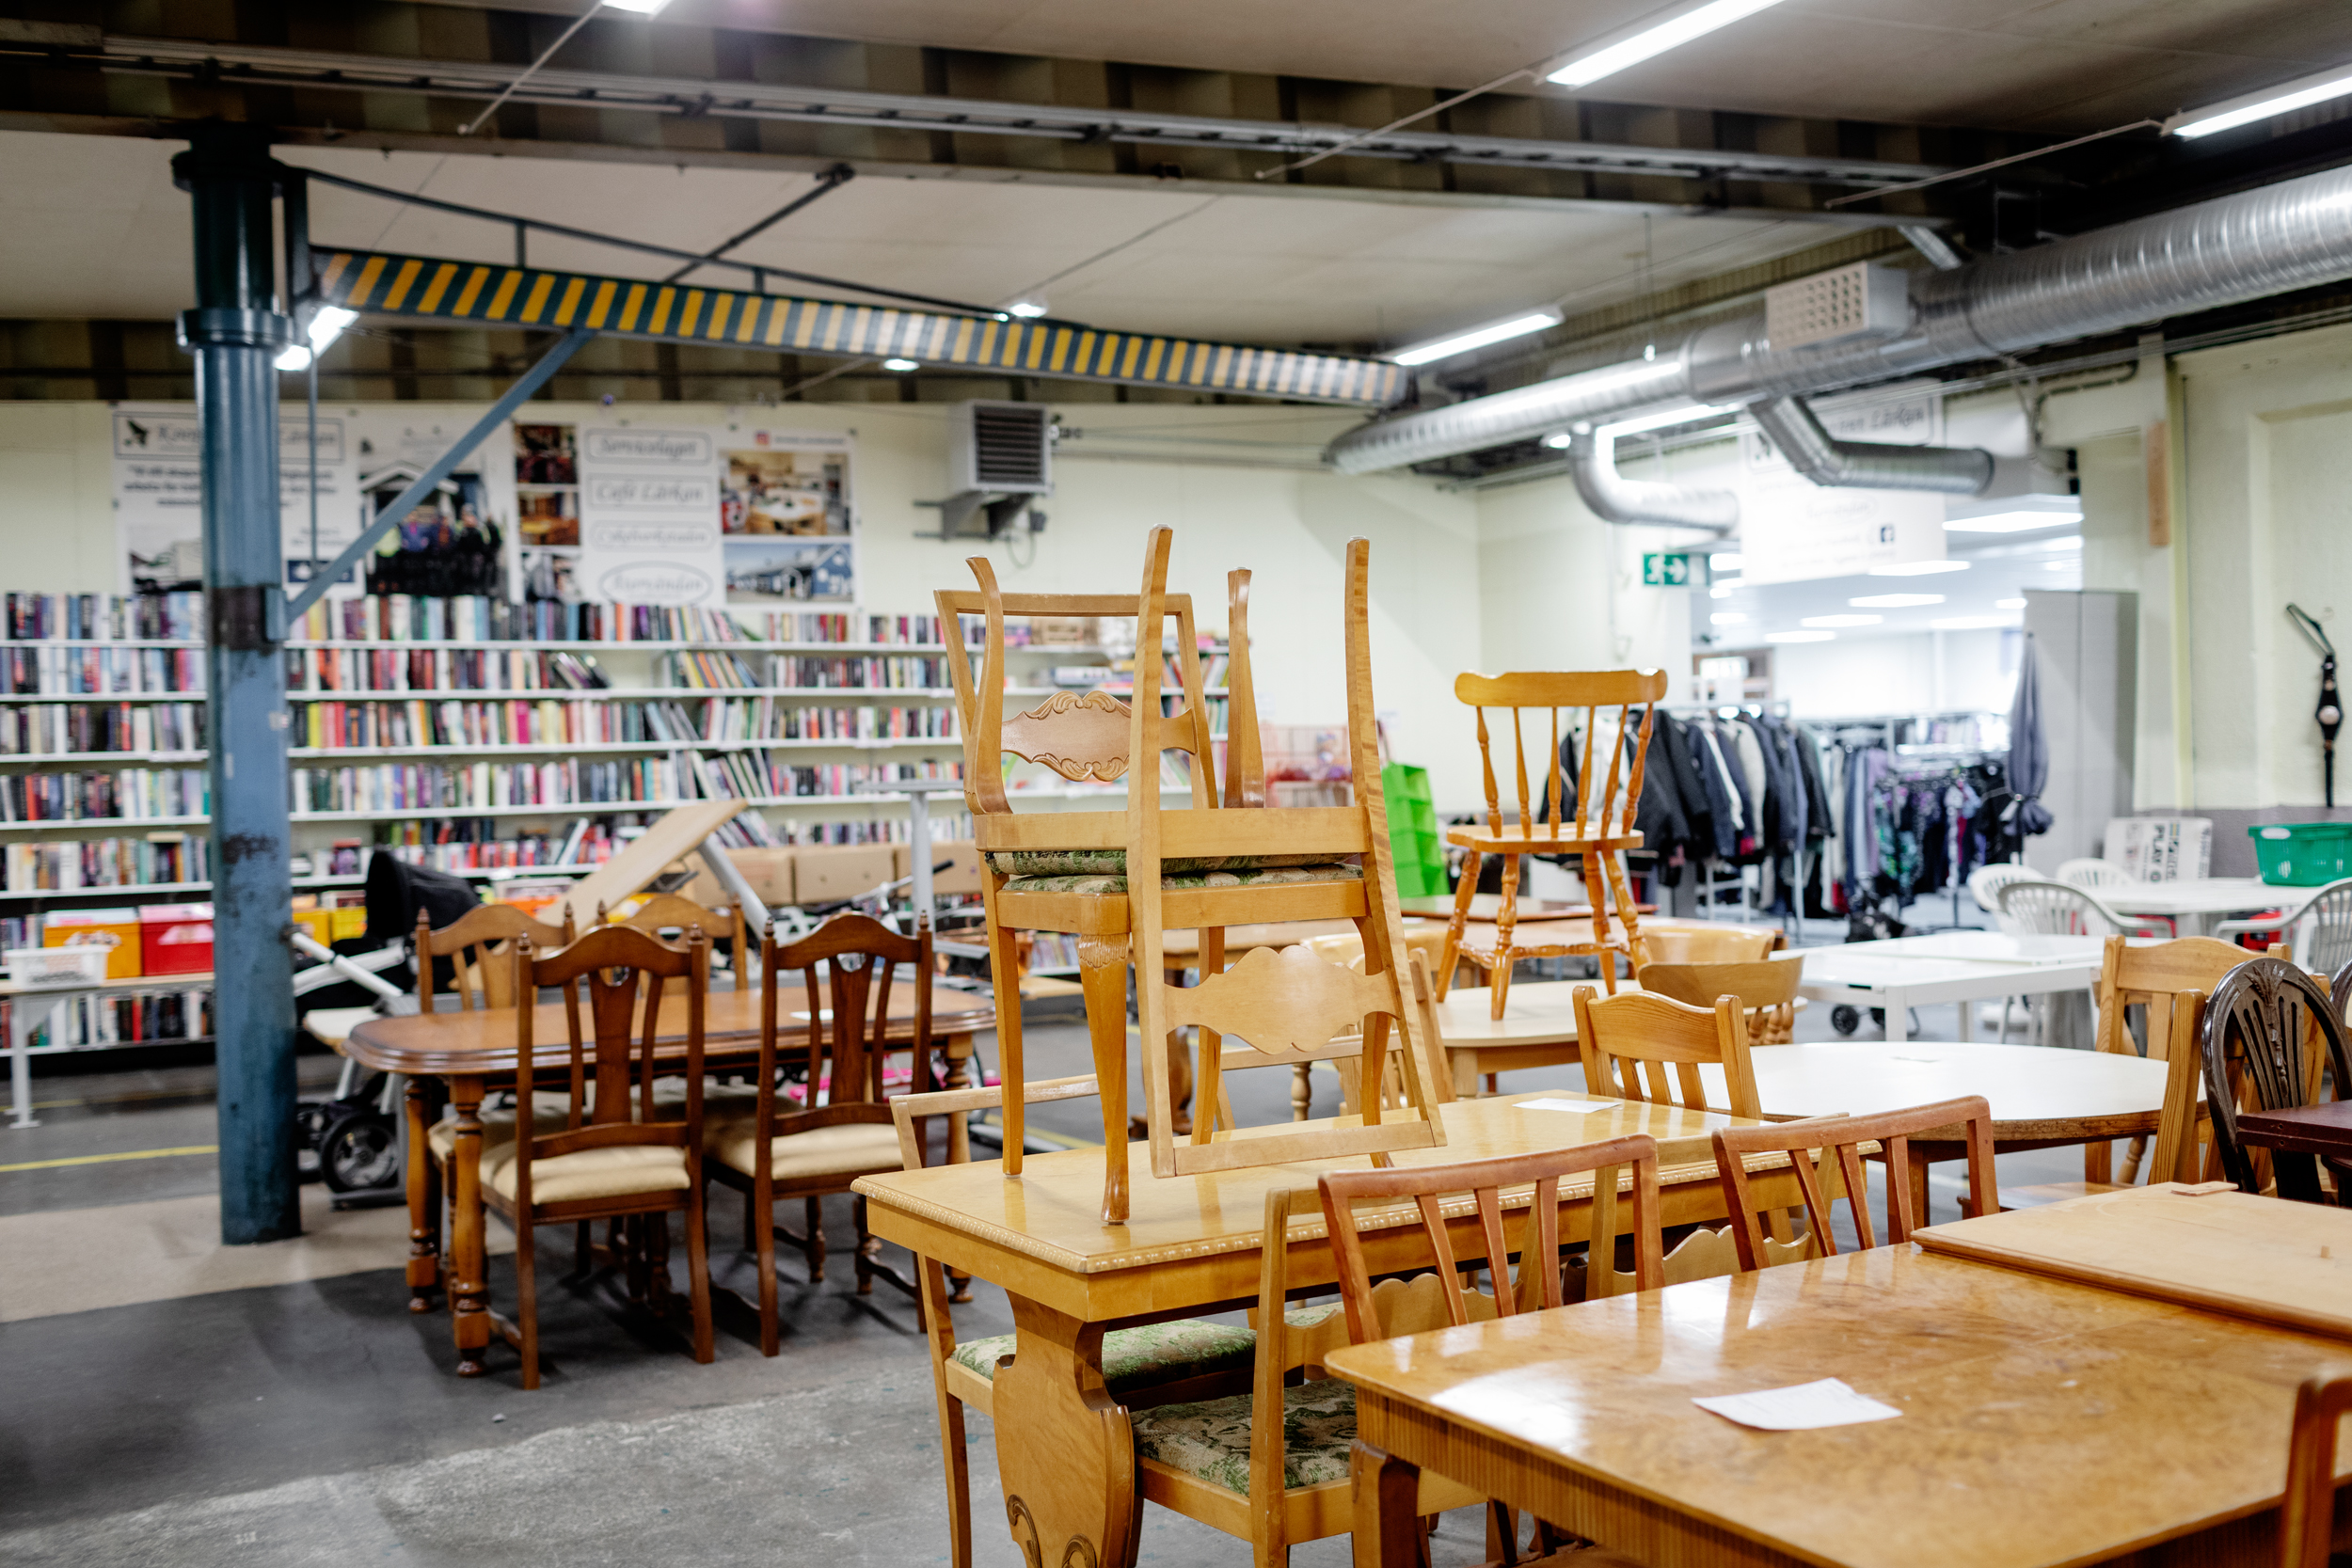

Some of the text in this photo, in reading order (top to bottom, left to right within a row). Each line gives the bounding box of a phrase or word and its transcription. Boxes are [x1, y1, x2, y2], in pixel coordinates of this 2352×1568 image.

[596, 481, 703, 506] Café Lärkan
[2152, 824, 2165, 864] PLAY
